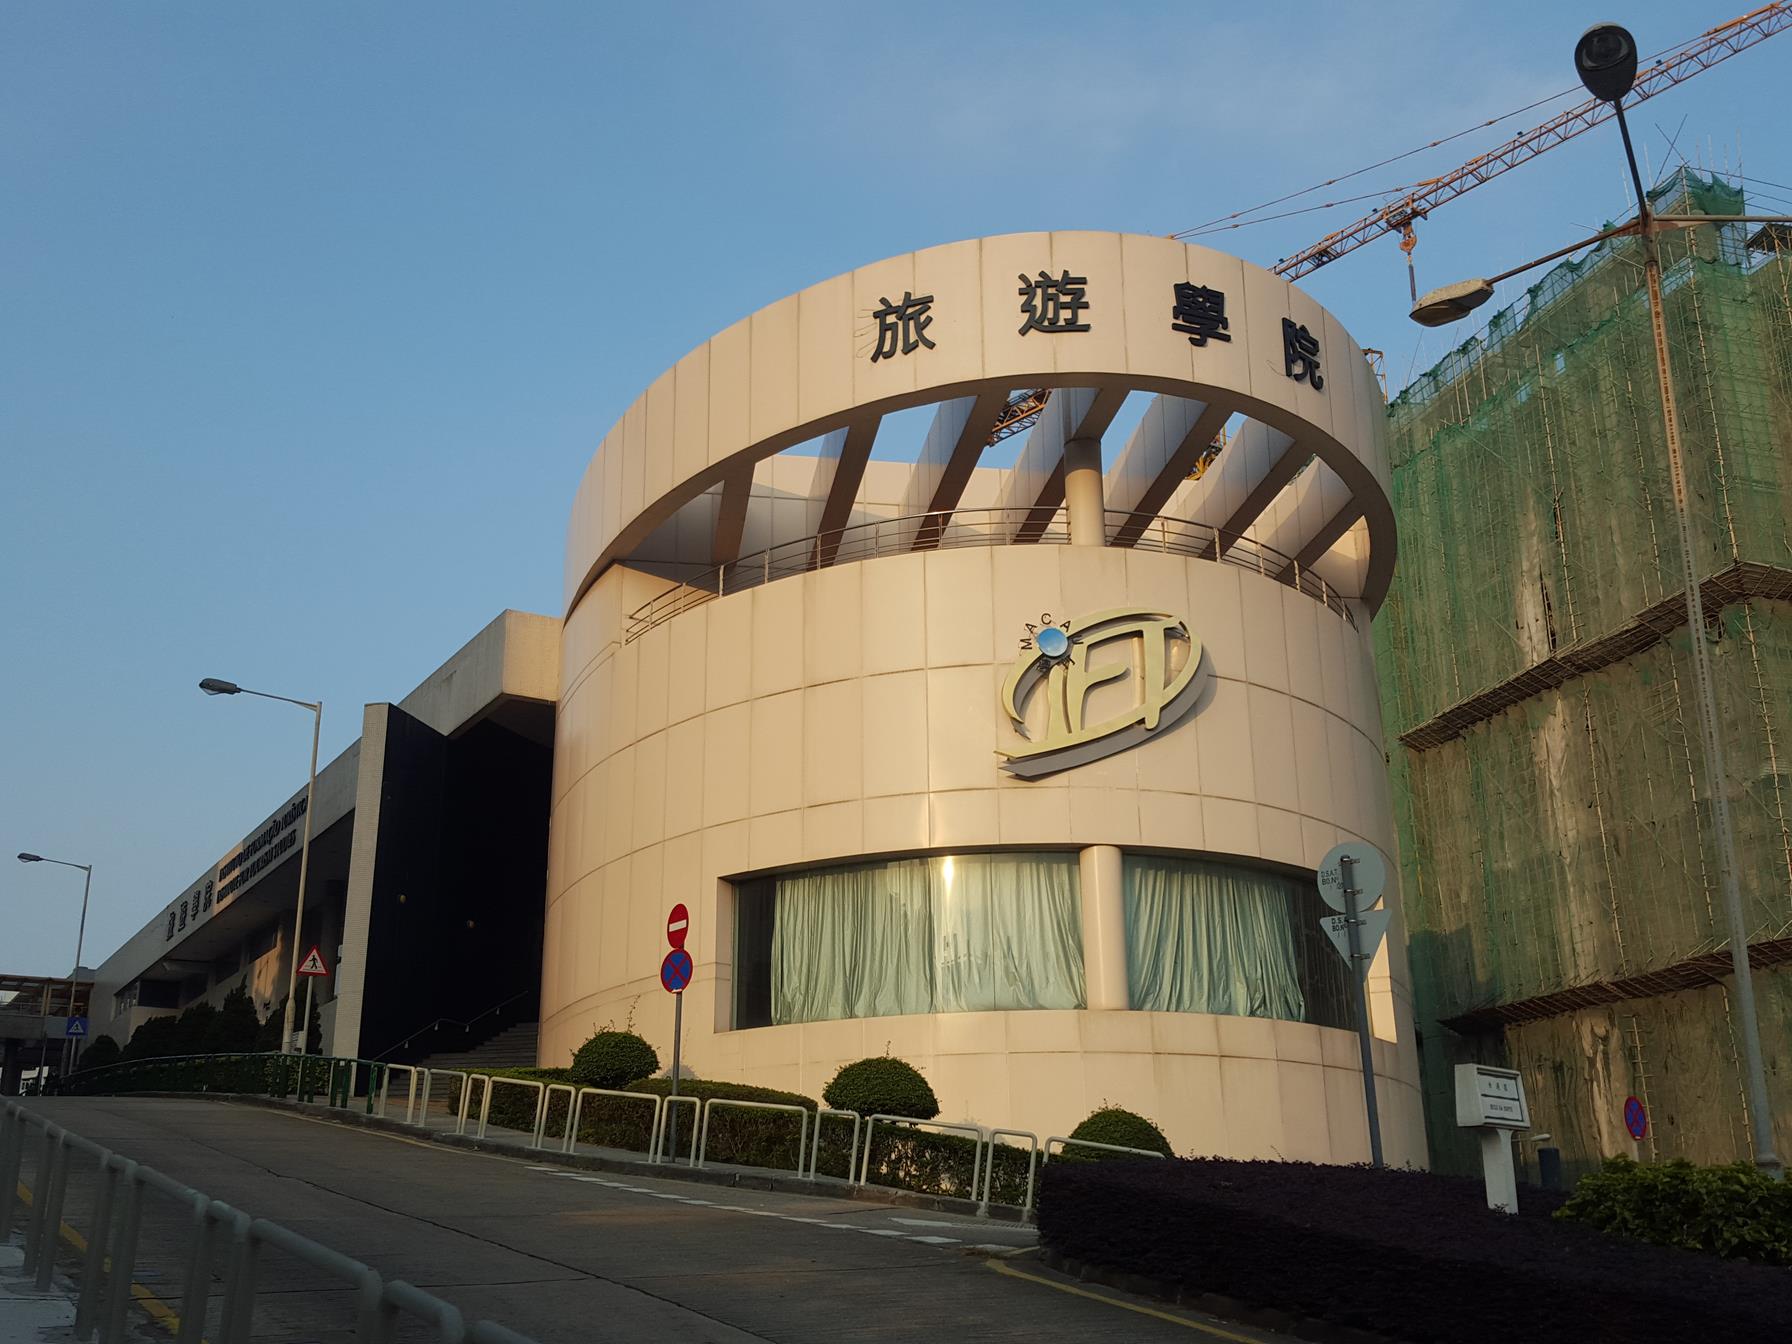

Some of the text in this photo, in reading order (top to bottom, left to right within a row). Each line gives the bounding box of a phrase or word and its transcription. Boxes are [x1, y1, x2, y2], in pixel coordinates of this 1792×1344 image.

[871, 269, 1324, 391] 旅遊學院
[1019, 612, 1084, 650] MACAU
